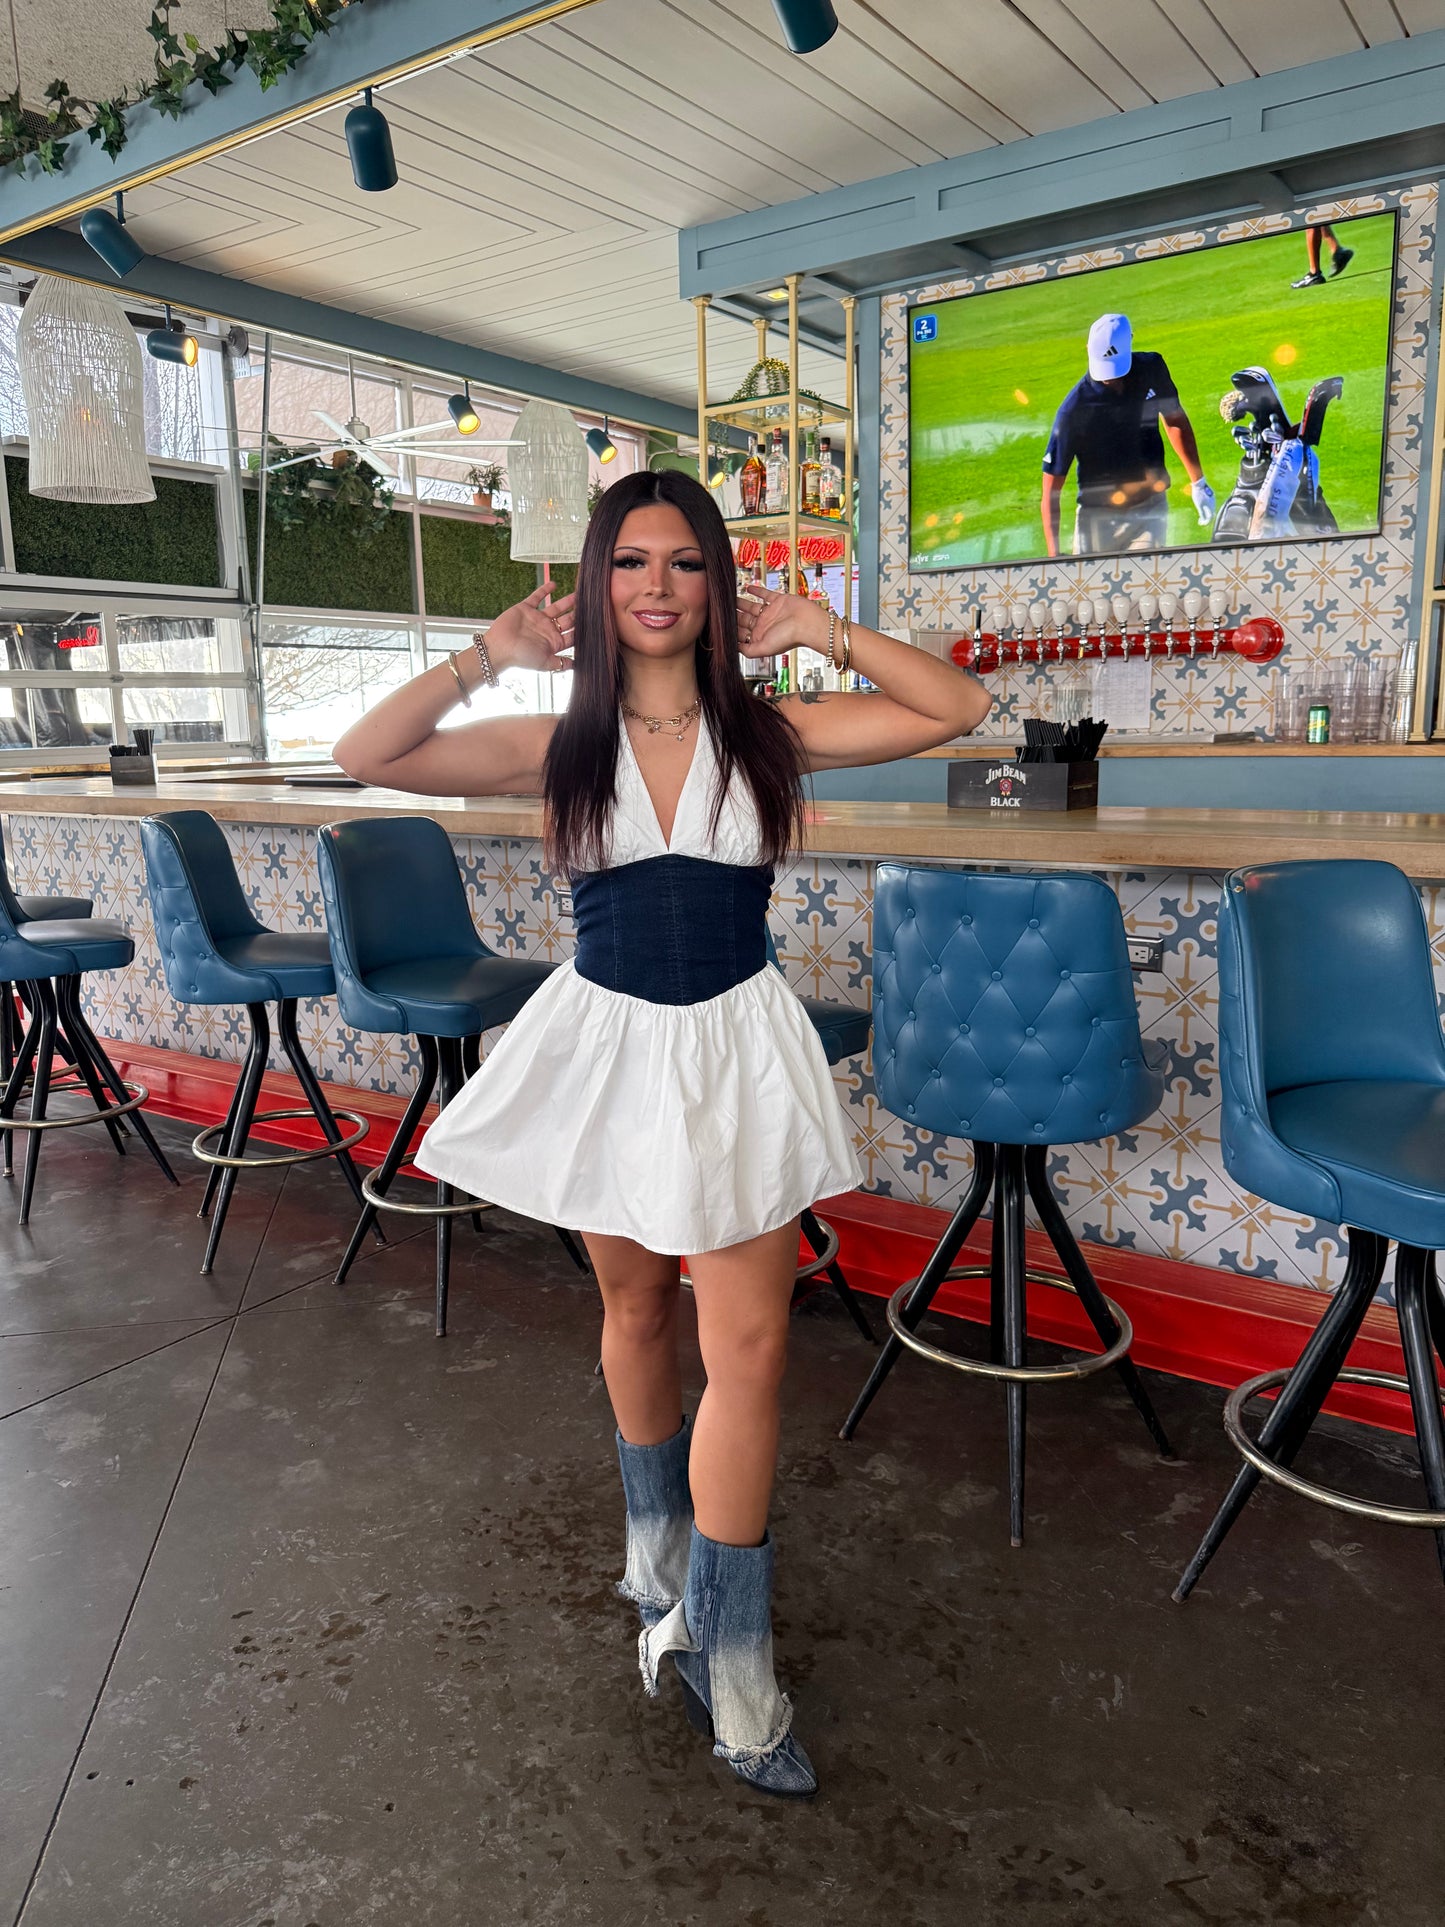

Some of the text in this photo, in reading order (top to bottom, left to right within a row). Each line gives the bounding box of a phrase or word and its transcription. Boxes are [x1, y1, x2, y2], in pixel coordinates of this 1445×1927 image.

[920, 319, 928, 329] 2
[797, 536, 838, 561] Here
[985, 764, 1027, 785] JIM BEAM
[990, 796, 1021, 807] BLACK
